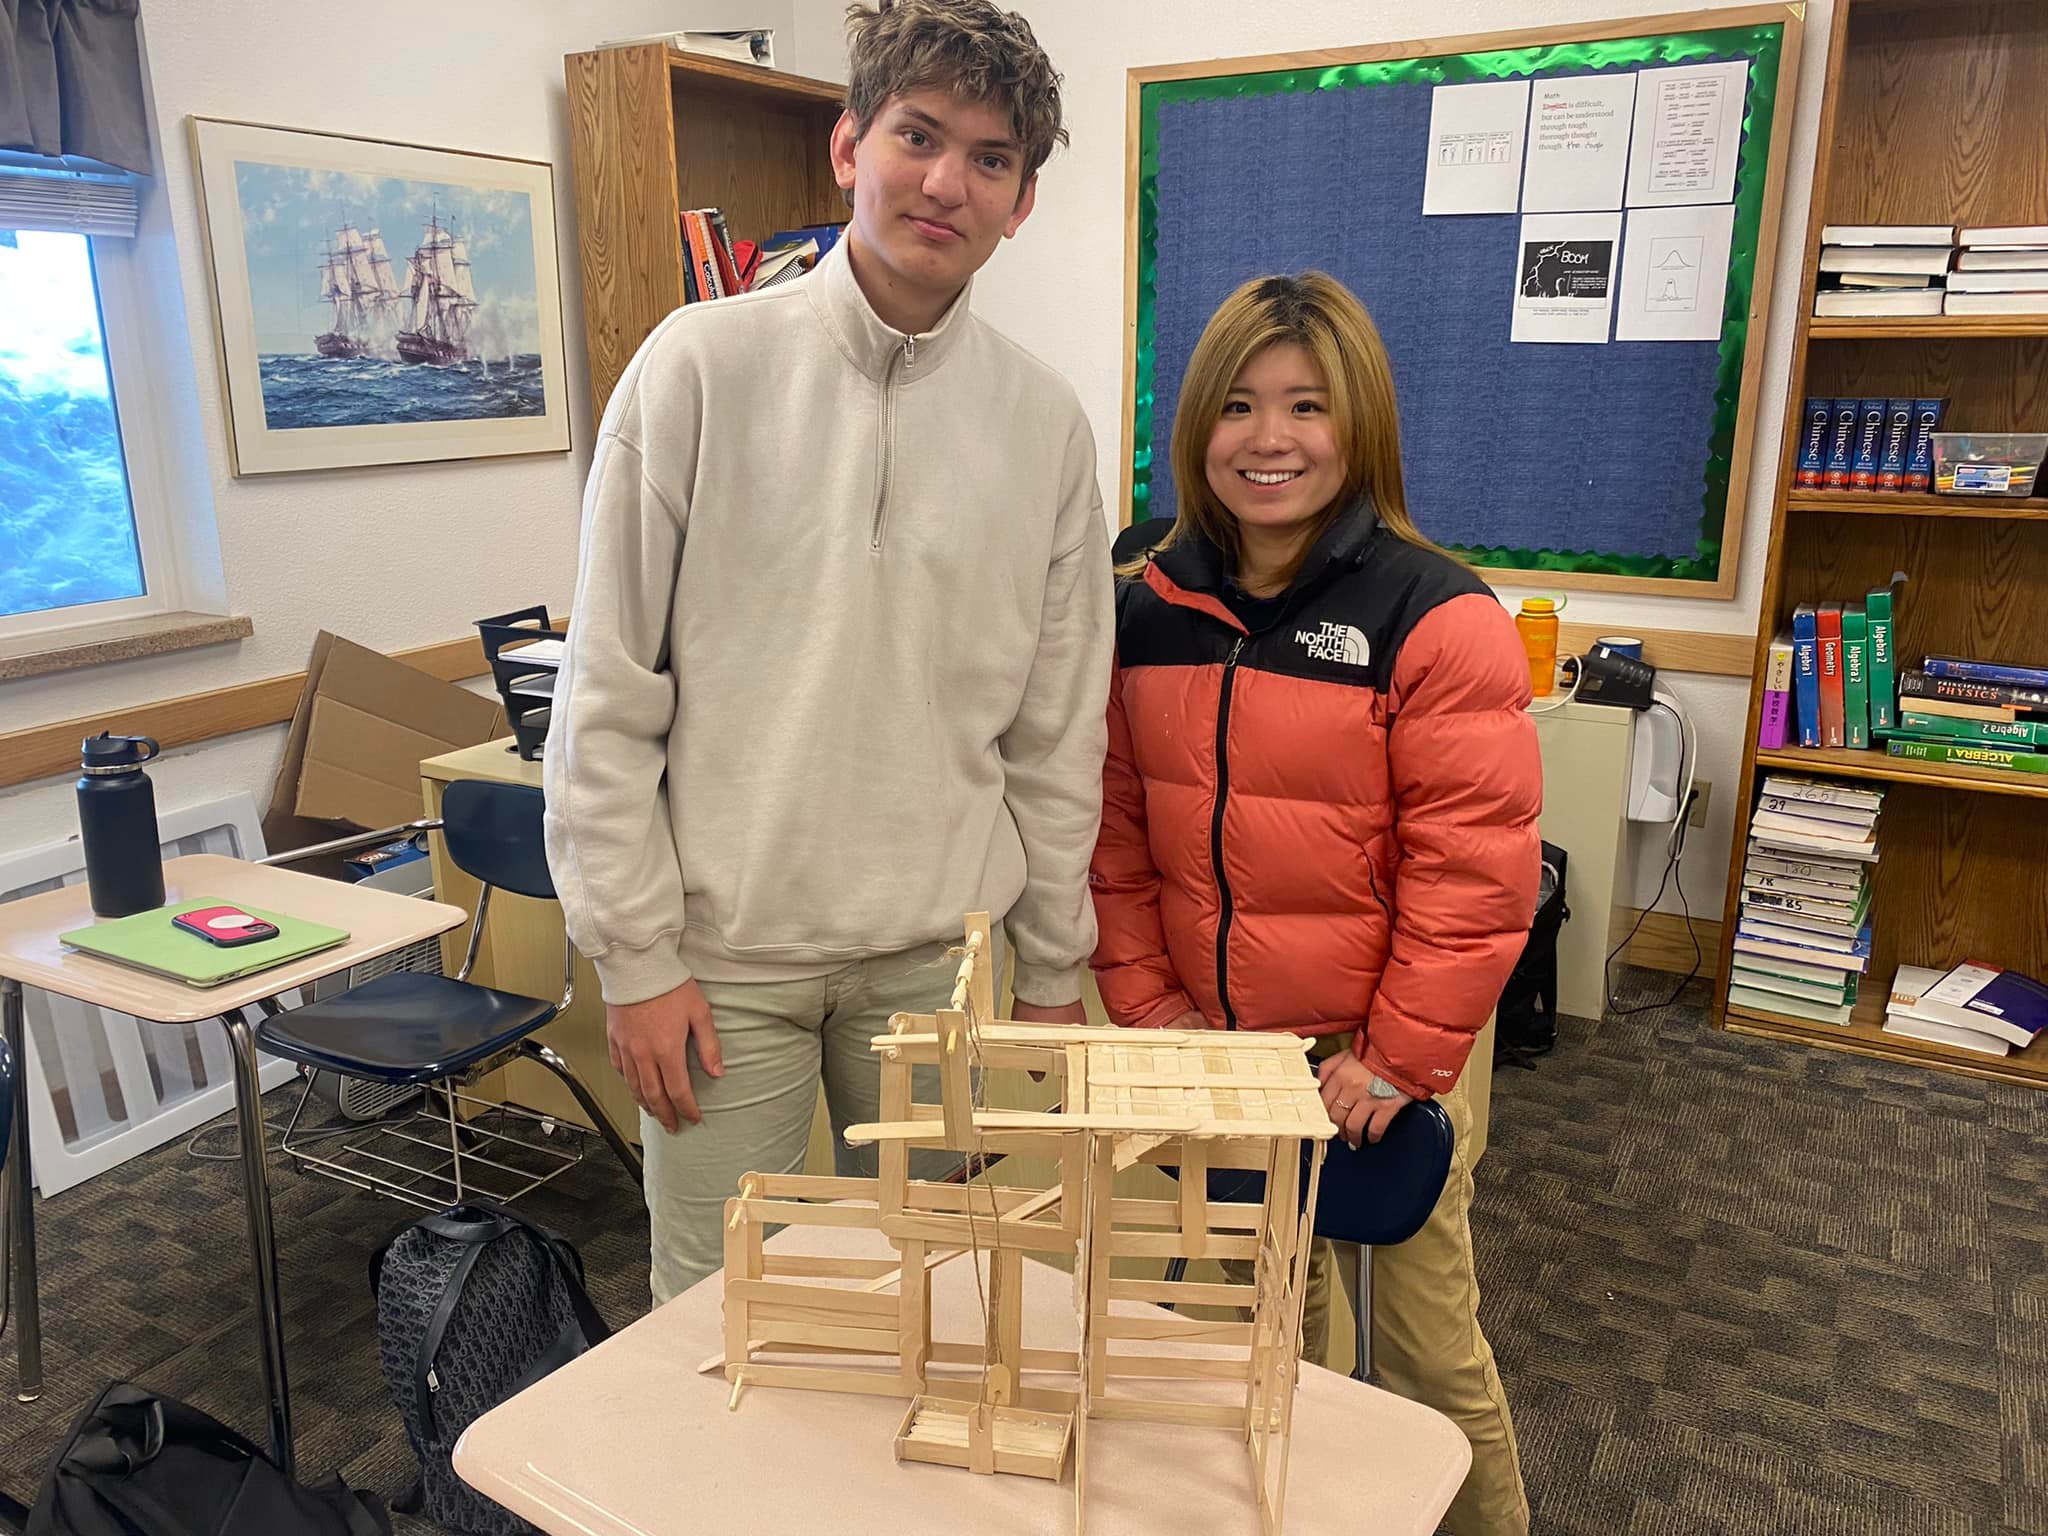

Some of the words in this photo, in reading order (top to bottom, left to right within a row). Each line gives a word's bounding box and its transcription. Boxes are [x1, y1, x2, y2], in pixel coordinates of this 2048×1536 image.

[1575, 109, 1615, 118] understood
[1540, 122, 1567, 131] through
[1560, 250, 1589, 264] BOOM
[1808, 410, 1828, 461] Chinese
[1834, 410, 1854, 461] Chinese
[1861, 411, 1881, 462] Chinese
[1888, 411, 1908, 463] Chinese
[1915, 411, 1936, 463] Chinese
[1320, 621, 1348, 638] THE
[1294, 630, 1345, 650] NORTH
[1873, 625, 1887, 657] Algebra
[1307, 645, 1343, 663] FACE
[1798, 645, 1812, 671] Algebra
[1823, 642, 1836, 676] Geometry
[1848, 646, 1861, 677] Algebra
[1937, 680, 1987, 690] PRINCIPLES
[1937, 685, 1998, 700] PHYSICS
[1982, 724, 1990, 734] 2
[1990, 724, 2029, 738] Algebra
[1955, 749, 2014, 763] ALGEBRA
[1768, 799, 1786, 811] 29
[1759, 877, 1774, 886] 18
[1785, 899, 1803, 911] 85
[1431, 1068, 1453, 1077] 700
